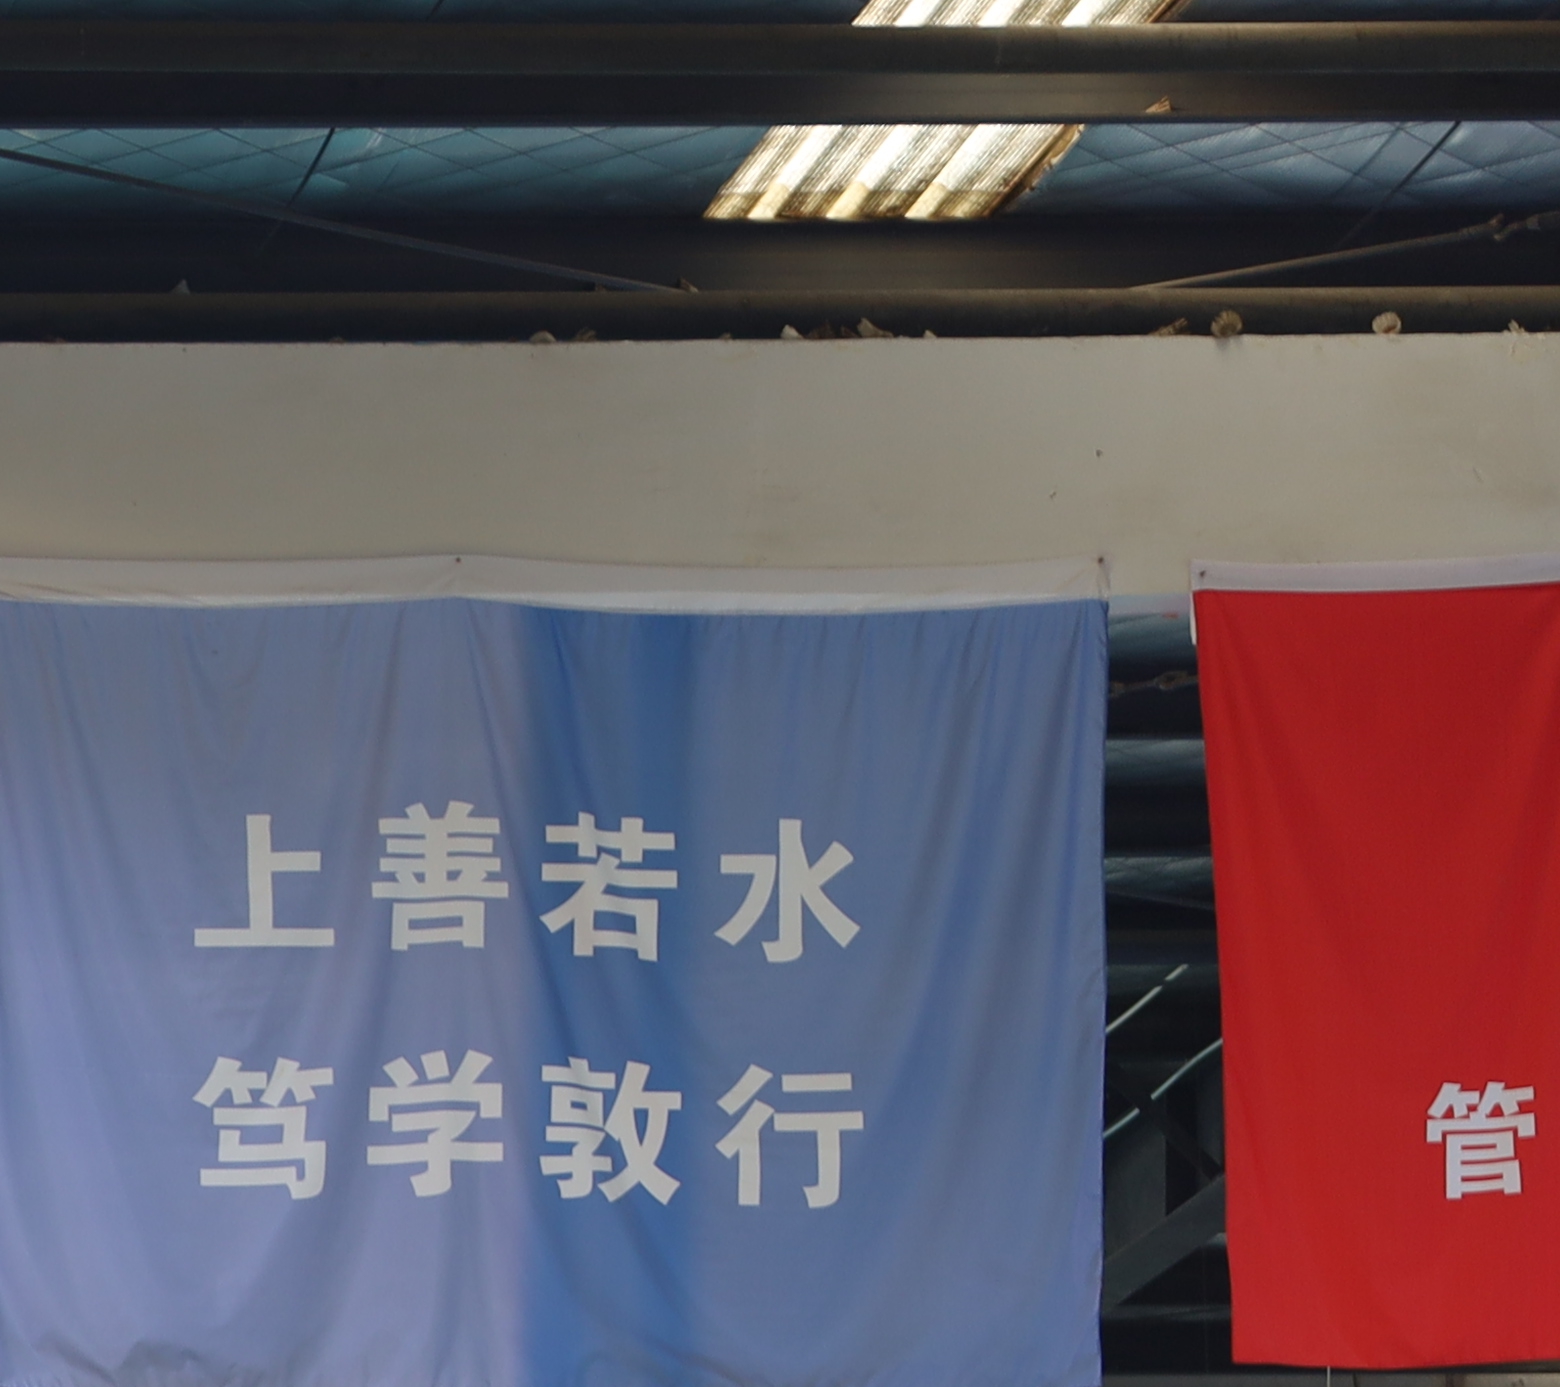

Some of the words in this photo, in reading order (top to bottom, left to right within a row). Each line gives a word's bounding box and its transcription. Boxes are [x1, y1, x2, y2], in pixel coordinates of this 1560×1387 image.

[194, 800, 860, 959] 上善若水
[195, 1050, 863, 1209] 笃学敦行
[1426, 1081, 1537, 1200] 管
